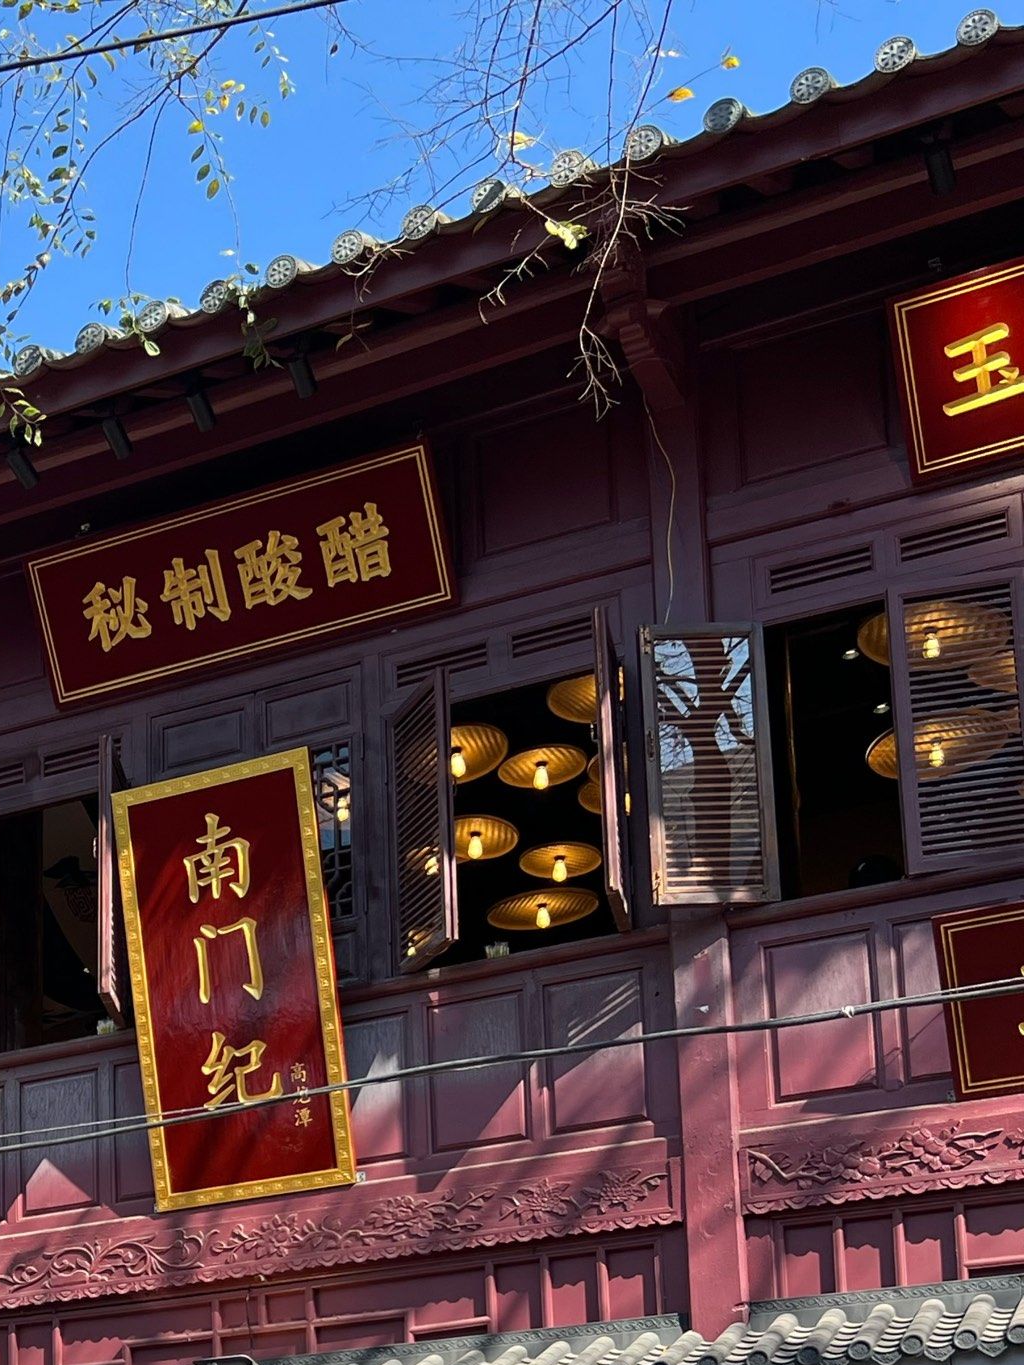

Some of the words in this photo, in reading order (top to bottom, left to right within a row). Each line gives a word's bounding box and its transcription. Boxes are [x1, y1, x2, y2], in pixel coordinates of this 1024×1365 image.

[943, 322, 1024, 416] 玉
[83, 502, 391, 652] 秘制酸醋
[183, 813, 283, 1111] 南门纪
